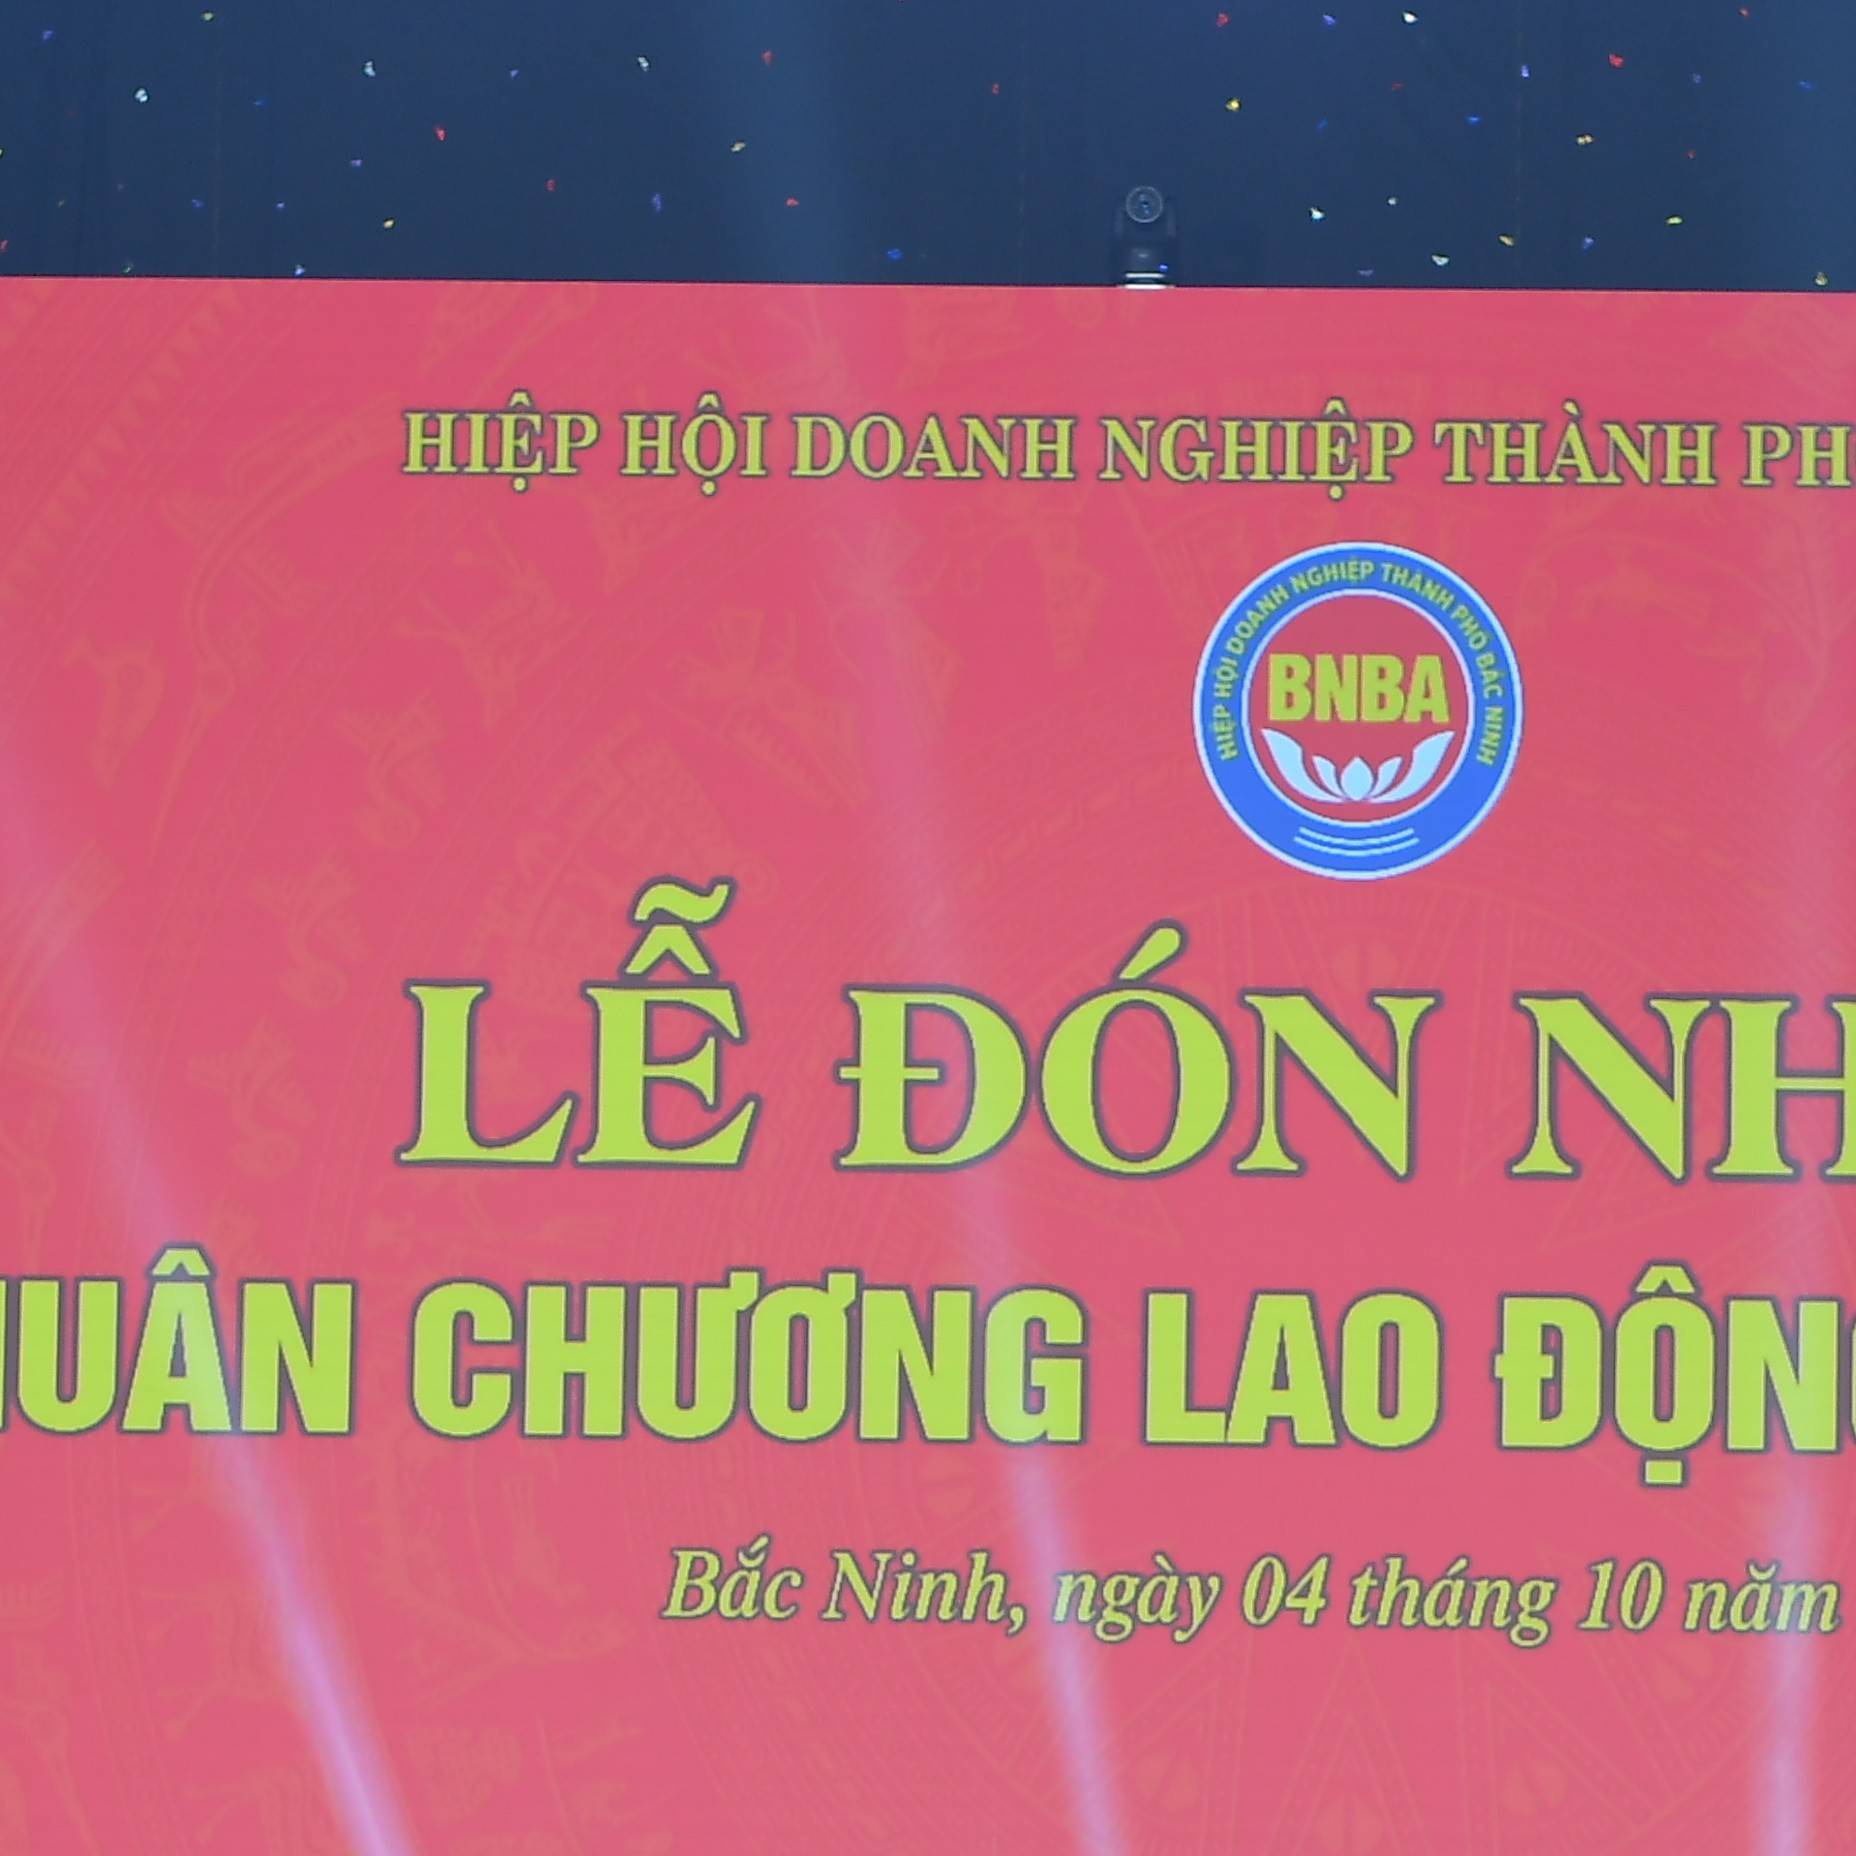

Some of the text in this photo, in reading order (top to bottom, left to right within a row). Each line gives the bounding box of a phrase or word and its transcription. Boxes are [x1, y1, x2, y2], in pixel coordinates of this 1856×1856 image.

[404, 390, 600, 493] HIỆP
[622, 391, 767, 496] HỘI
[793, 413, 1075, 481] DOANH
[1101, 397, 1416, 501] NGHIỆP
[1434, 400, 1718, 487] THÀNH
[1289, 557, 1375, 594] NGHIỆP
[1380, 562, 1457, 611] THÀNH
[1227, 584, 1291, 655] DOANH
[1214, 656, 1239, 699] HỘI
[1267, 651, 1453, 726] BNBA
[1213, 703, 1239, 761] HIỆP
[1476, 705, 1505, 766] NINH
[399, 879, 760, 1170] LỄ
[836, 923, 1439, 1179] ĐÓN
[409, 1267, 1087, 1452] CHƯƠNG
[1144, 1289, 1444, 1452] LAO
[664, 1535, 805, 1621] Bắc
[824, 1549, 1027, 1632] Ninh,
[1055, 1553, 1223, 1644] ngày
[1241, 1555, 1331, 1627] 04
[1348, 1555, 1558, 1650] tháng
[1581, 1559, 1666, 1632] 10
[1684, 1566, 1841, 1634] năm
